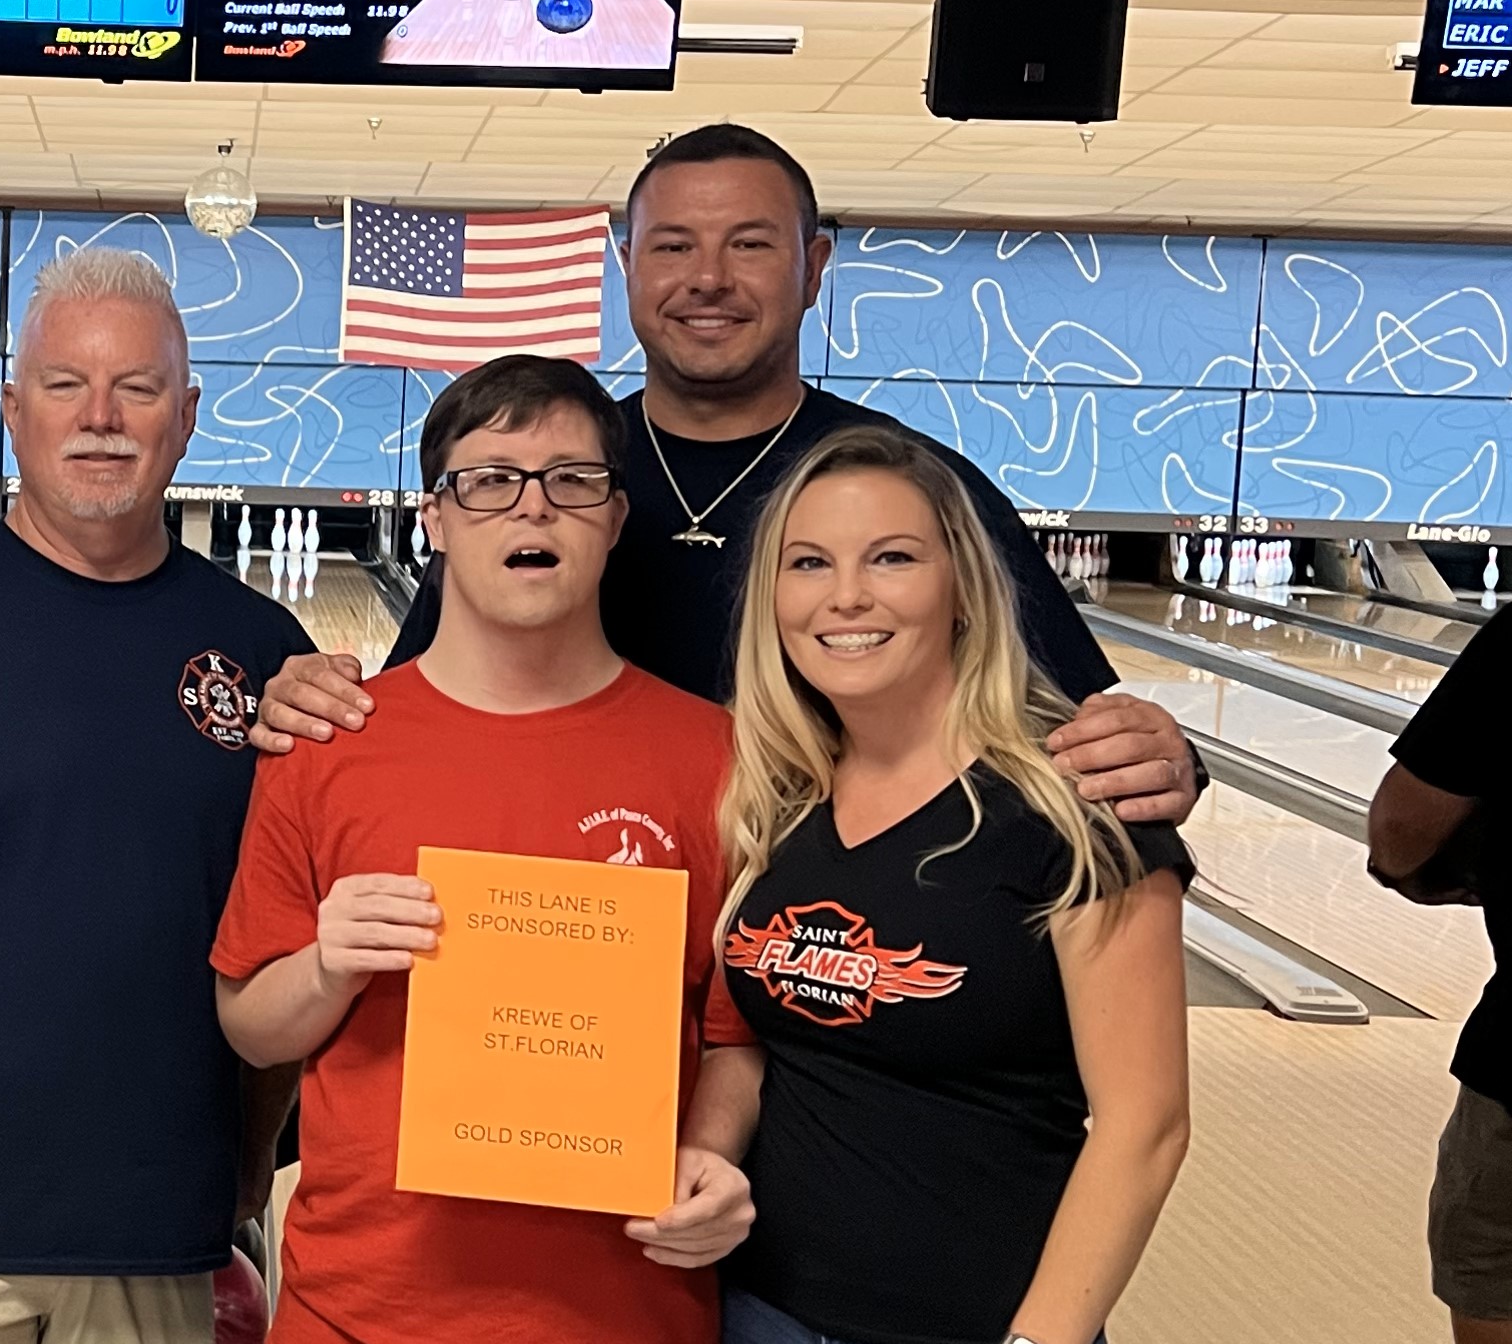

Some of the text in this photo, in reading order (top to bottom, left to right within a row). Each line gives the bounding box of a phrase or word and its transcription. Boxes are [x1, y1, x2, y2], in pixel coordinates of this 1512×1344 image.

[225, 2, 273, 16] Current
[274, 2, 301, 16] Ball
[56, 27, 140, 45] Bowland
[281, 23, 307, 35] Ball
[1450, 25, 1509, 43] ERIC
[88, 44, 128, 56] 11.98
[1452, 59, 1510, 77] JEFF
[368, 490, 394, 506] 28
[1199, 515, 1227, 532] 32
[1240, 516, 1491, 543] 33 Lane-Glo
[208, 653, 224, 672] K
[183, 687, 198, 705] S
[488, 888, 617, 915] THIS LANE IS
[467, 913, 634, 944] SPONSORED BY:
[792, 925, 850, 945] SAINT
[759, 940, 877, 989] FLAMES
[781, 980, 855, 1006] FLORIAN
[493, 1006, 598, 1031] KREWE OF
[454, 1123, 623, 1156] GOLD SPONSOR
